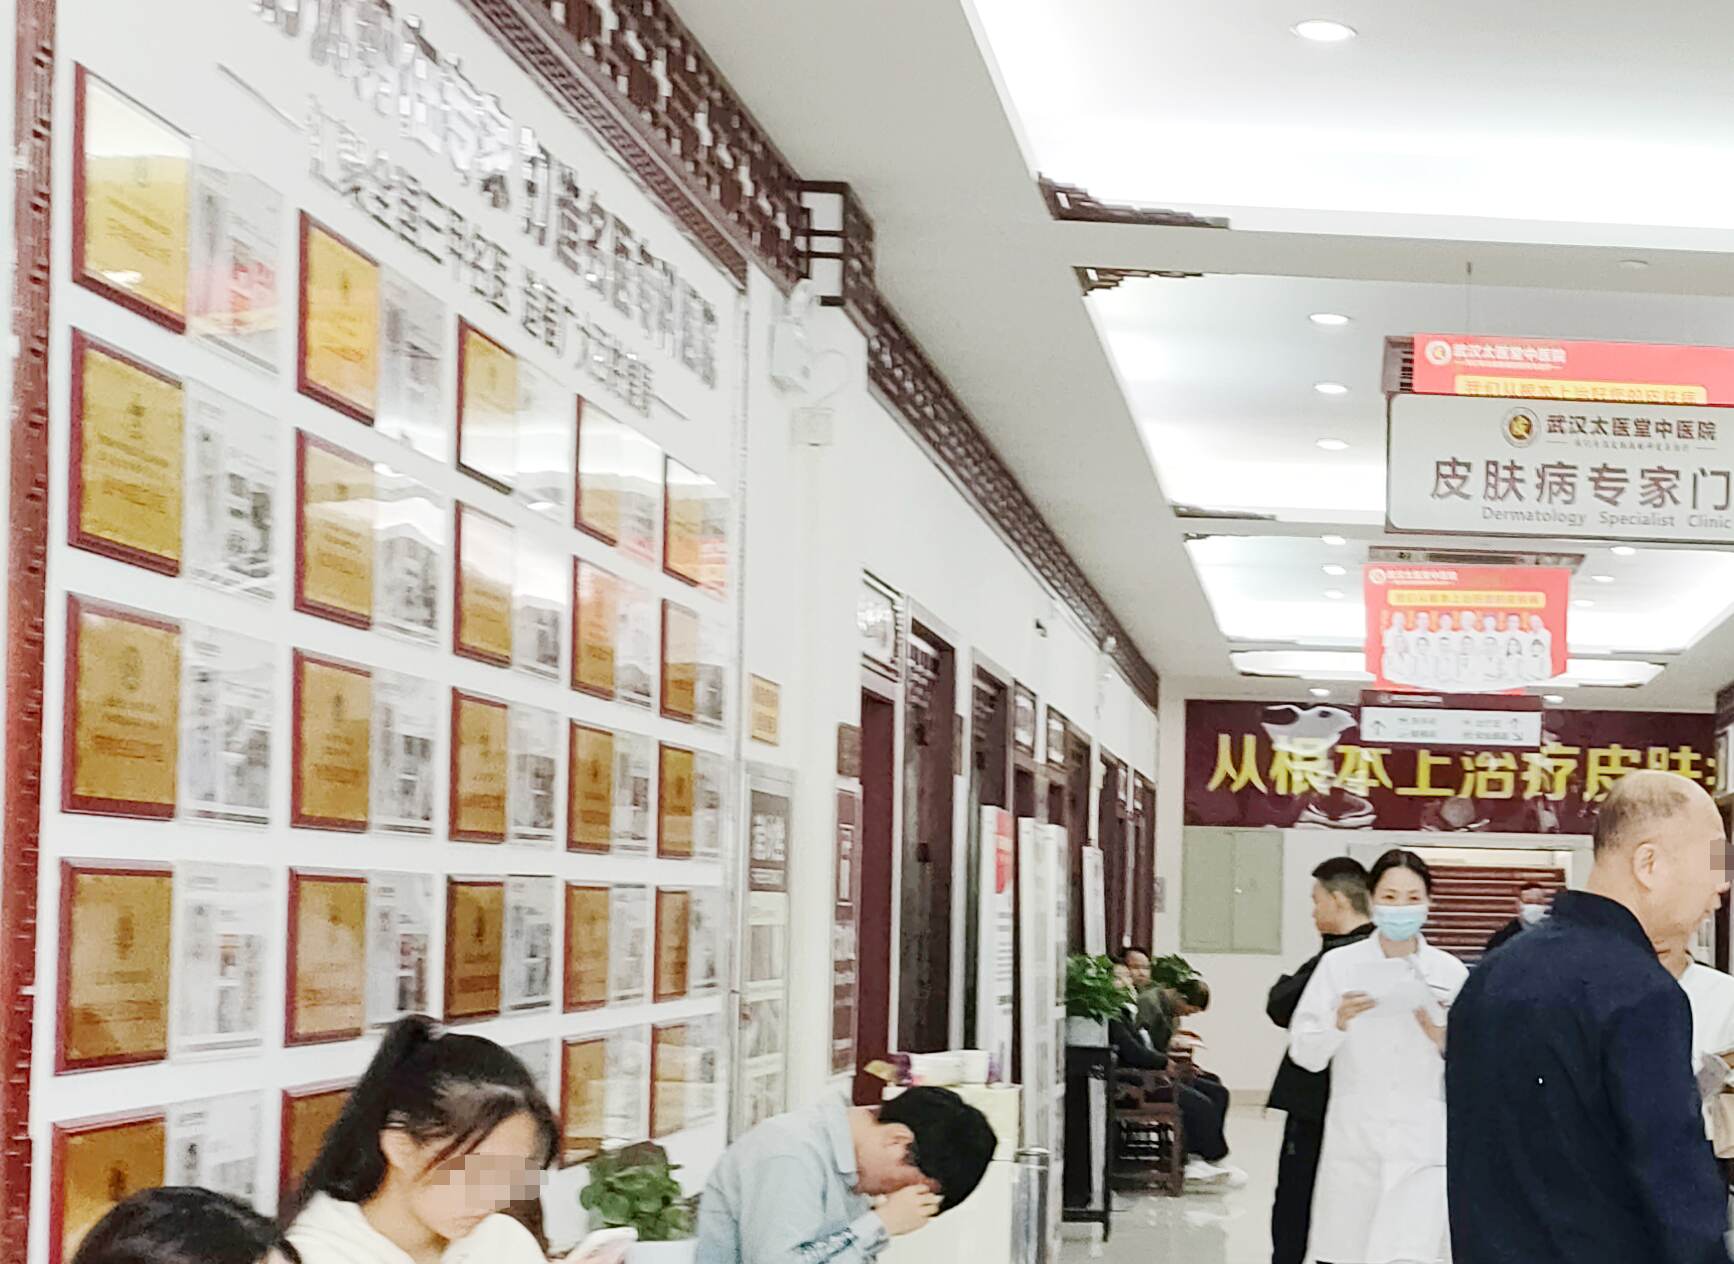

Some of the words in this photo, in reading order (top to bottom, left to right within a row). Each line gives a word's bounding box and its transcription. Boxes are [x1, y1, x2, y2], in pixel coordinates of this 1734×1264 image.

[1546, 414, 1717, 441] 武汉太医堂中医院
[1482, 506, 1587, 527] Dermatology
[1598, 511, 1676, 528] Specialist
[1688, 514, 1732, 529] Clinic
